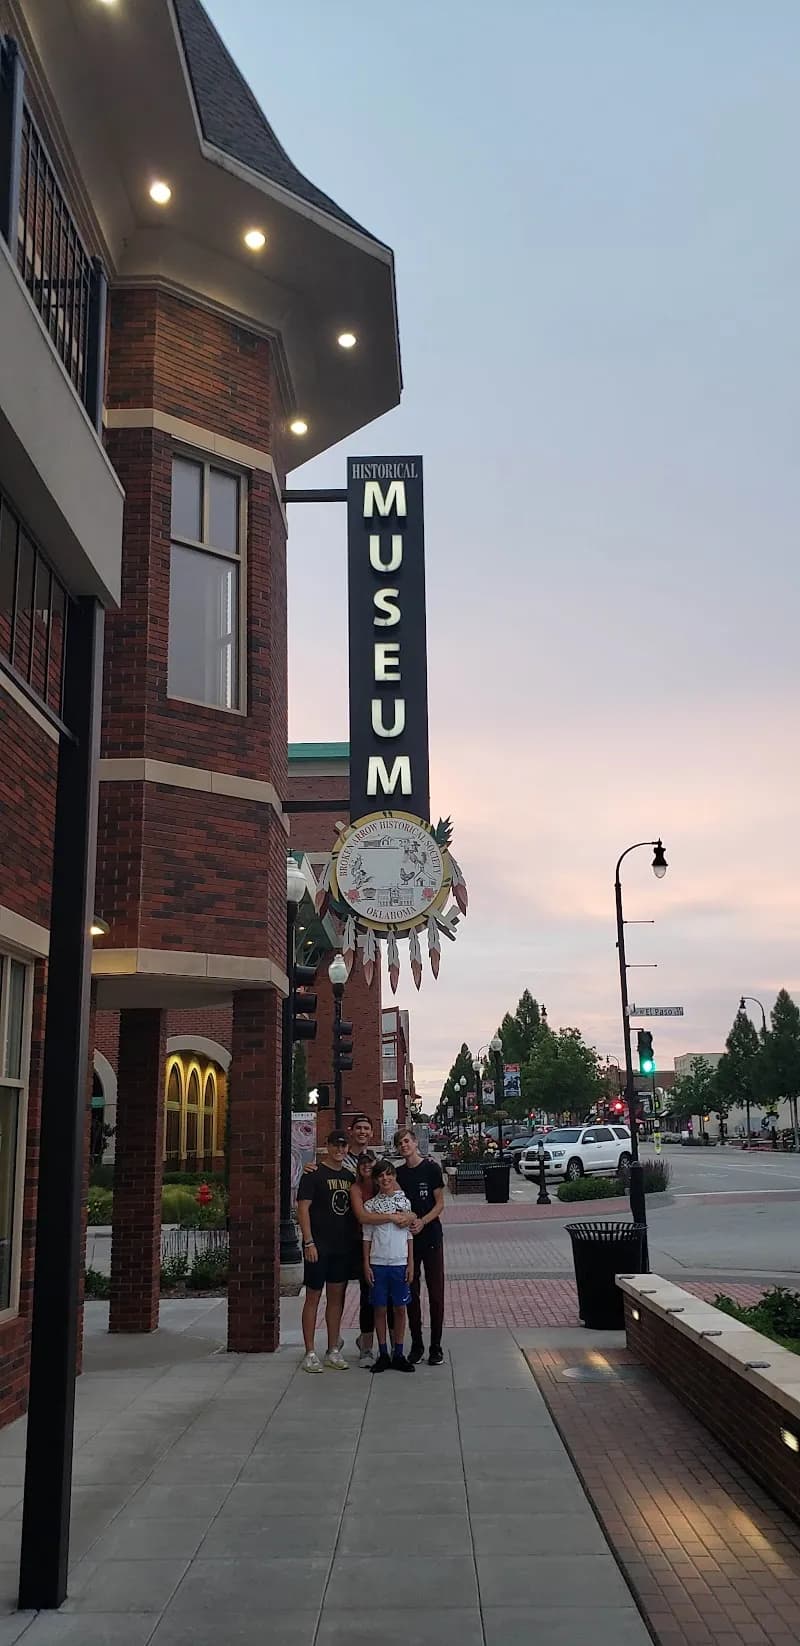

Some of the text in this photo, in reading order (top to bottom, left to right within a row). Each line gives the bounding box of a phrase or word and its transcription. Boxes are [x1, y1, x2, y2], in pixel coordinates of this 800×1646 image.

[352, 462, 418, 479] HISTORICAL
[362, 480, 412, 797] MUSEUM
[339, 820, 442, 877] BROKEN ARROW HISTORICAL SOCIETY
[366, 905, 418, 920] OKLAHOMA
